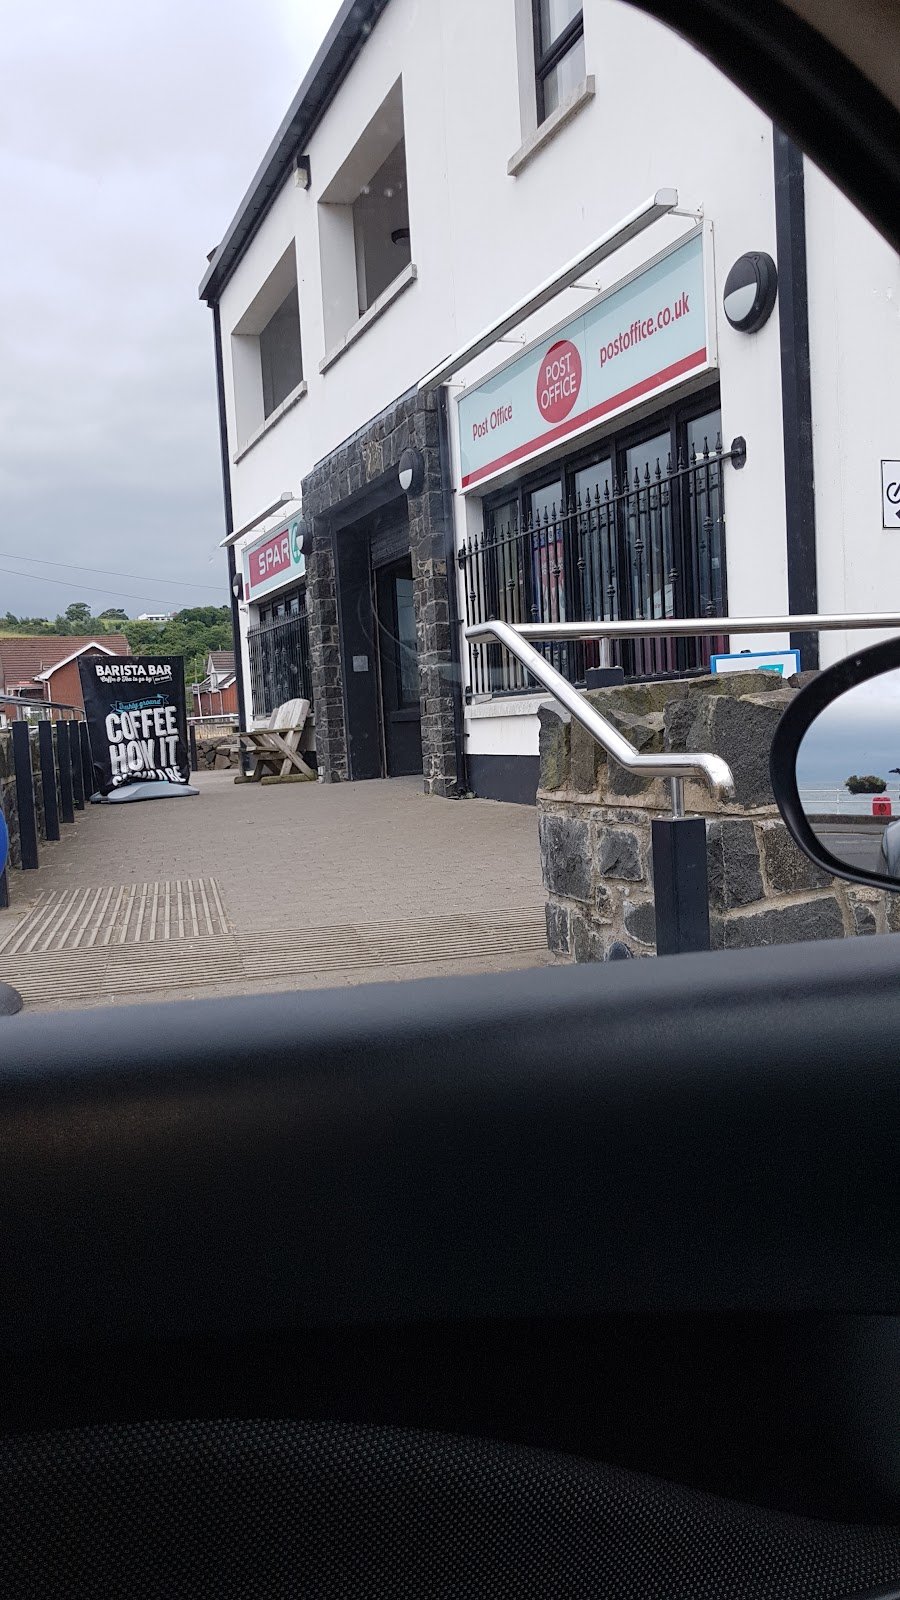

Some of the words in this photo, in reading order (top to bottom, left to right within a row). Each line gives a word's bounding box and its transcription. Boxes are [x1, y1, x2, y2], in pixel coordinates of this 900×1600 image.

[599, 291, 690, 368] postoffice.co.uk
[545, 352, 572, 385] POST
[540, 373, 577, 410] OFFICE
[472, 418, 489, 442] Post
[489, 404, 513, 430] Office
[258, 538, 290, 575] SPAR
[95, 664, 147, 676] BARISTA
[147, 664, 172, 675] BAR
[105, 706, 178, 743] COFFEE
[109, 739, 156, 776] HOW
[159, 735, 180, 768] IT
